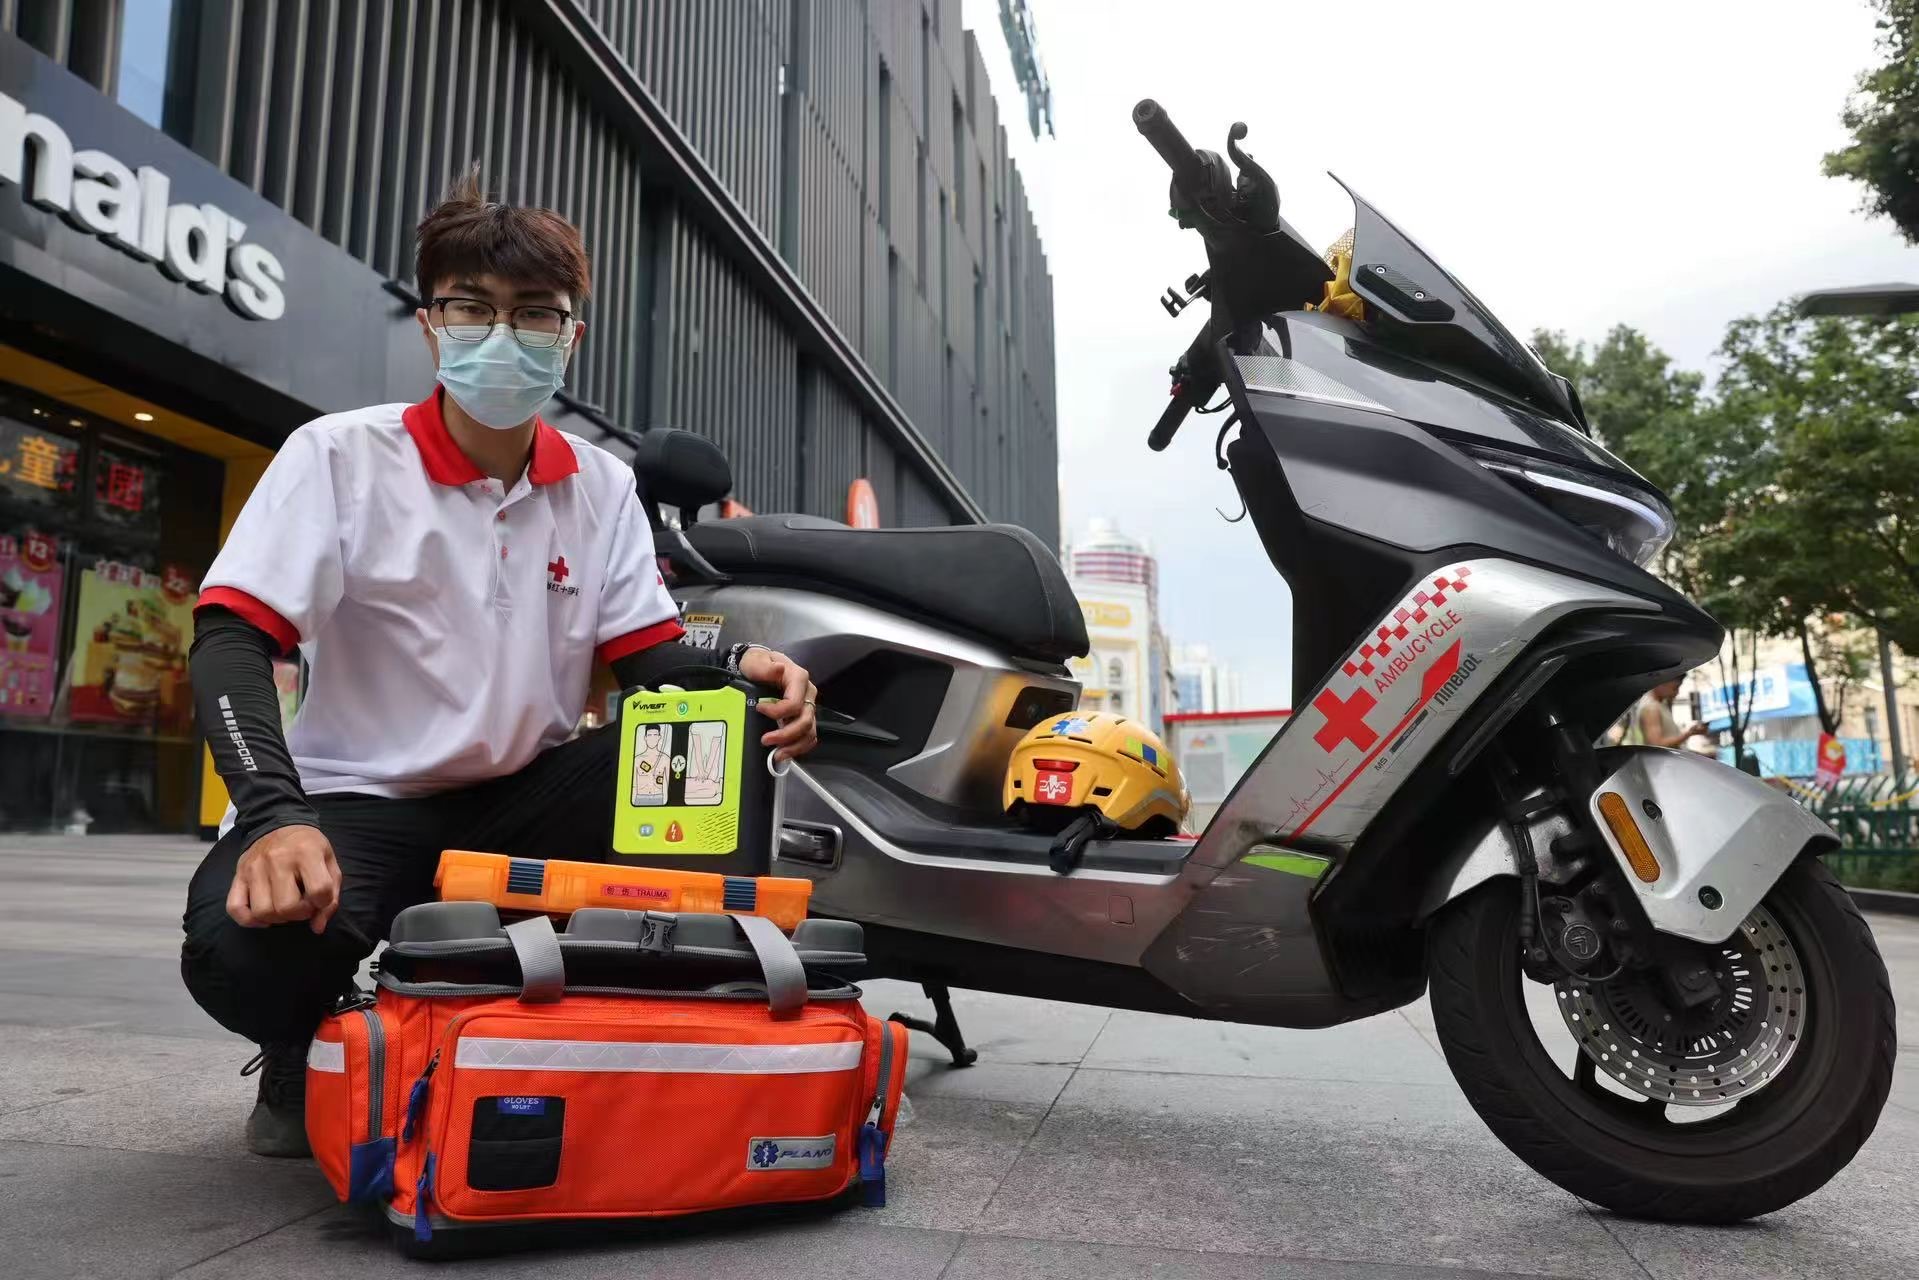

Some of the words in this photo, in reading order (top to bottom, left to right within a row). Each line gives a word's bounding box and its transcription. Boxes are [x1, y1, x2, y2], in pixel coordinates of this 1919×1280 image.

[1374, 609, 1463, 694] AMBUCYCLE
[639, 702, 667, 711] VIVEST
[637, 888, 668, 899] TRAUMA
[779, 1148, 832, 1159] PLANO
